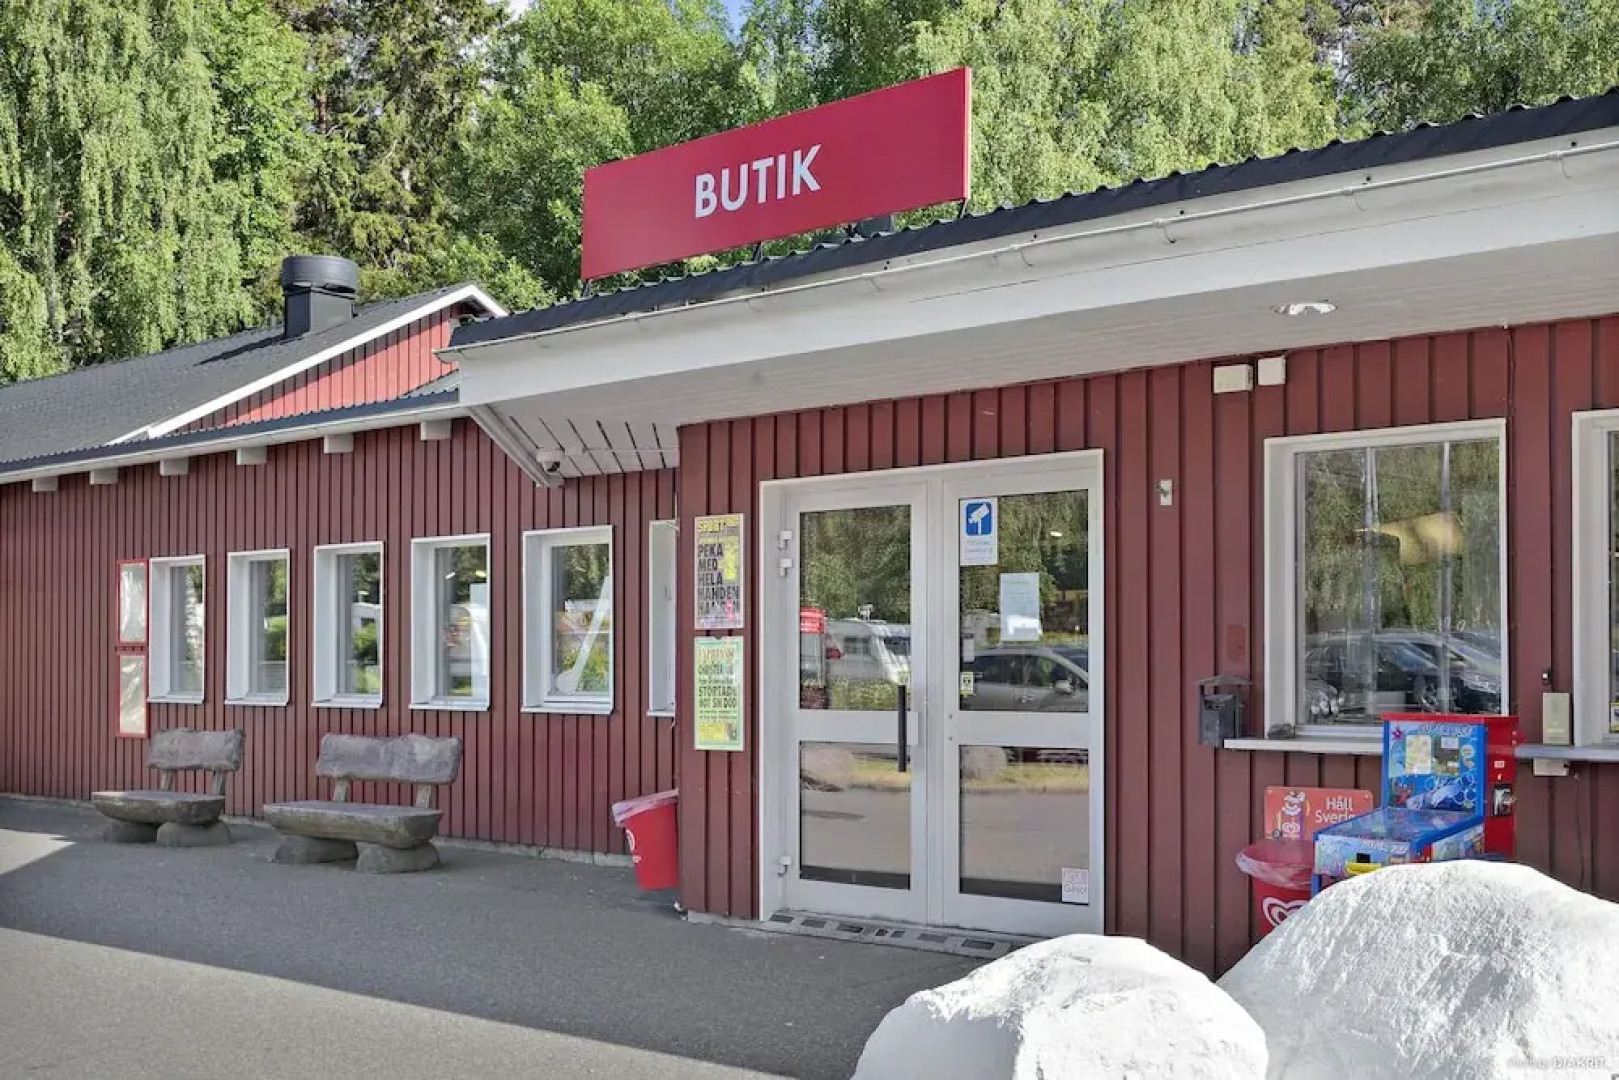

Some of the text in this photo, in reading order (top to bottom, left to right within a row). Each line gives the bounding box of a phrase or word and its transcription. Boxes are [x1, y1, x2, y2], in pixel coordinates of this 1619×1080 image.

[695, 144, 822, 218] BUTIK
[698, 543, 724, 558] PEKA
[698, 558, 718, 572] MED
[698, 570, 723, 586] HELA
[1325, 796, 1353, 811] Håll
[1315, 809, 1356, 823] Sveri
